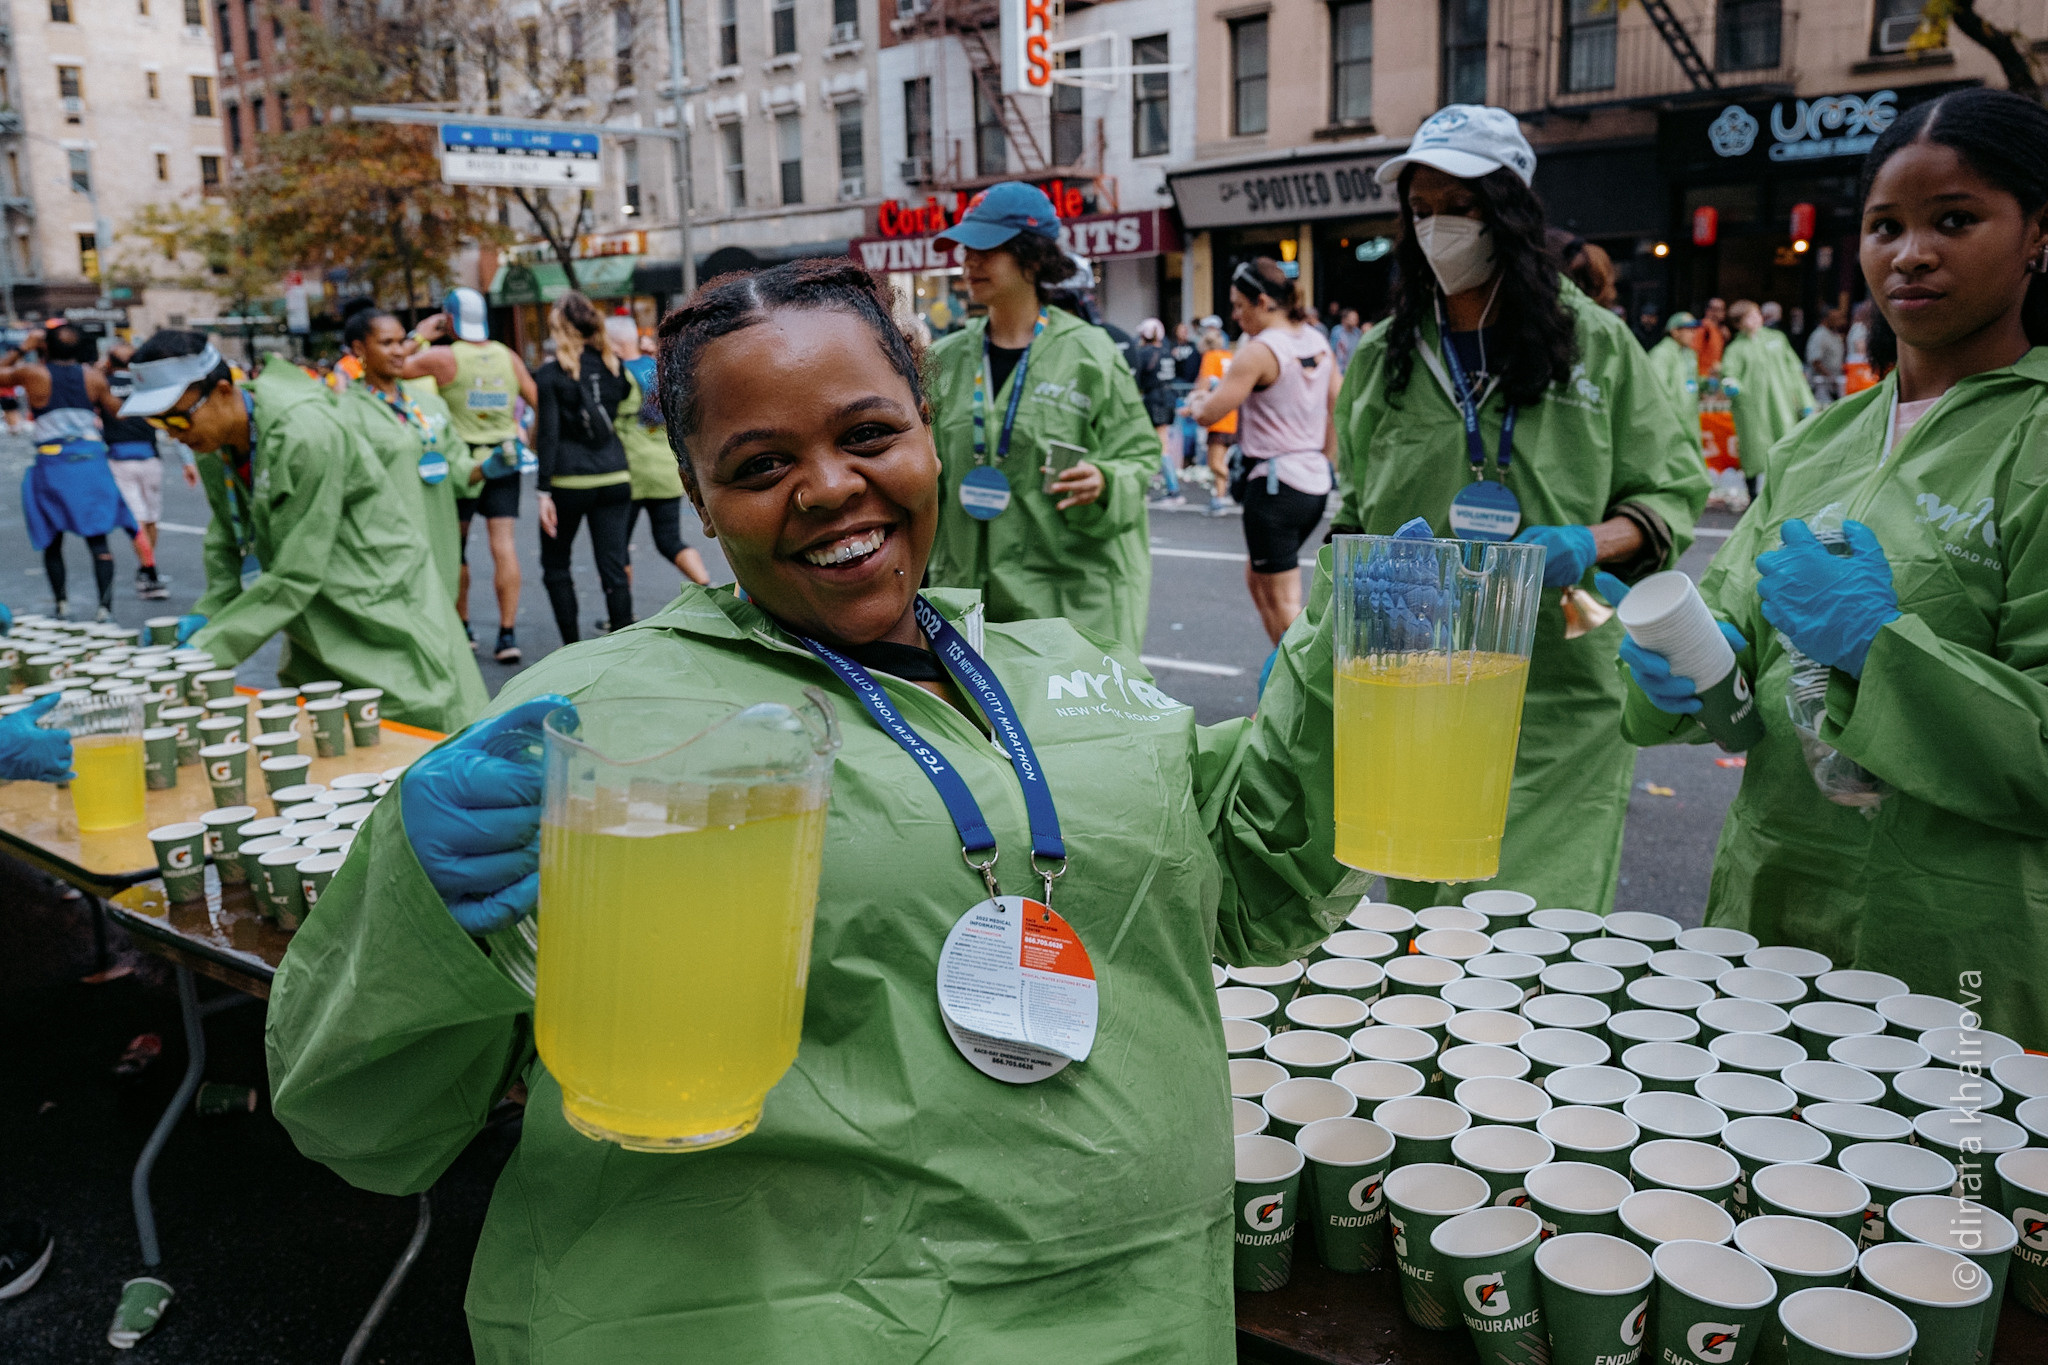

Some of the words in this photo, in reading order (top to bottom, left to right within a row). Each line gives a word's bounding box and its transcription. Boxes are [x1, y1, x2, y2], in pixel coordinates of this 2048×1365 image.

[1242, 169, 1333, 213] SPOTTED
[1334, 164, 1383, 202] DOG
[878, 195, 949, 237] Cork
[1058, 216, 1142, 257] RITS
[1454, 508, 1515, 524] VOLUNTEER
[1944, 542, 1981, 563] ROAD
[849, 670, 874, 693] CITY
[915, 600, 942, 640] 2022
[946, 640, 964, 661] TCS
[957, 657, 974, 675] NEW
[970, 669, 991, 692] YORK
[984, 691, 1005, 715] CITY
[998, 711, 1037, 781] MARATHON
[868, 693, 896, 724] YORK
[1055, 706, 1091, 718] NEW
[1091, 702, 1124, 719] YOK
[1124, 711, 1161, 722] ROAD
[892, 724, 920, 746] NEW
[914, 747, 945, 775] TCS
[167, 844, 193, 869] G
[969, 920, 1006, 931] INFORMATION
[989, 918, 1012, 927] MEDICAL
[999, 1053, 1030, 1063] EMERGENCY
[1348, 1169, 1385, 1213] G
[1243, 1191, 1284, 1232] G
[1329, 1203, 1388, 1228] ENDURAN
[1235, 1222, 1295, 1247] NDURANCE
[1397, 1255, 1435, 1283] RANCE
[1463, 1271, 1511, 1317] G
[1462, 1308, 1540, 1333] ENDURANCE
[1686, 1321, 1741, 1364] G
